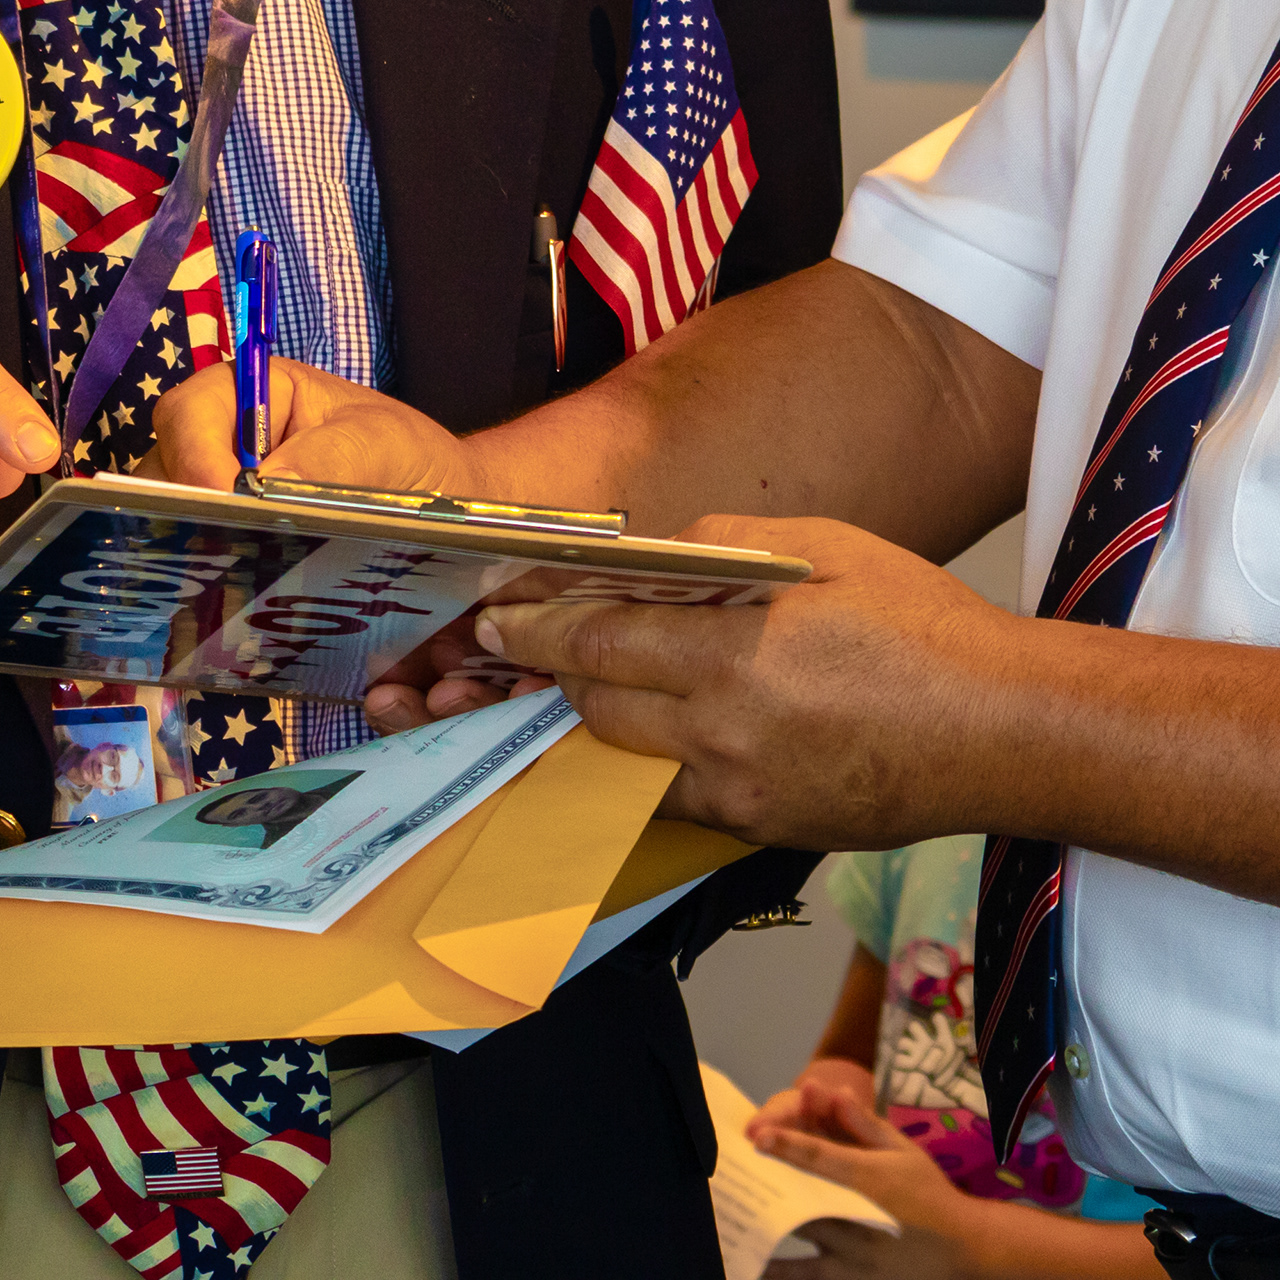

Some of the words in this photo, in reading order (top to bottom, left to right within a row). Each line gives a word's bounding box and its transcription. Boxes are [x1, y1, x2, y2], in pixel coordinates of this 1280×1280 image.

[9, 550, 242, 644] VOTE
[243, 594, 434, 637] to
[411, 741, 516, 824] DEPARTMENT
[515, 726, 537, 746] OF
